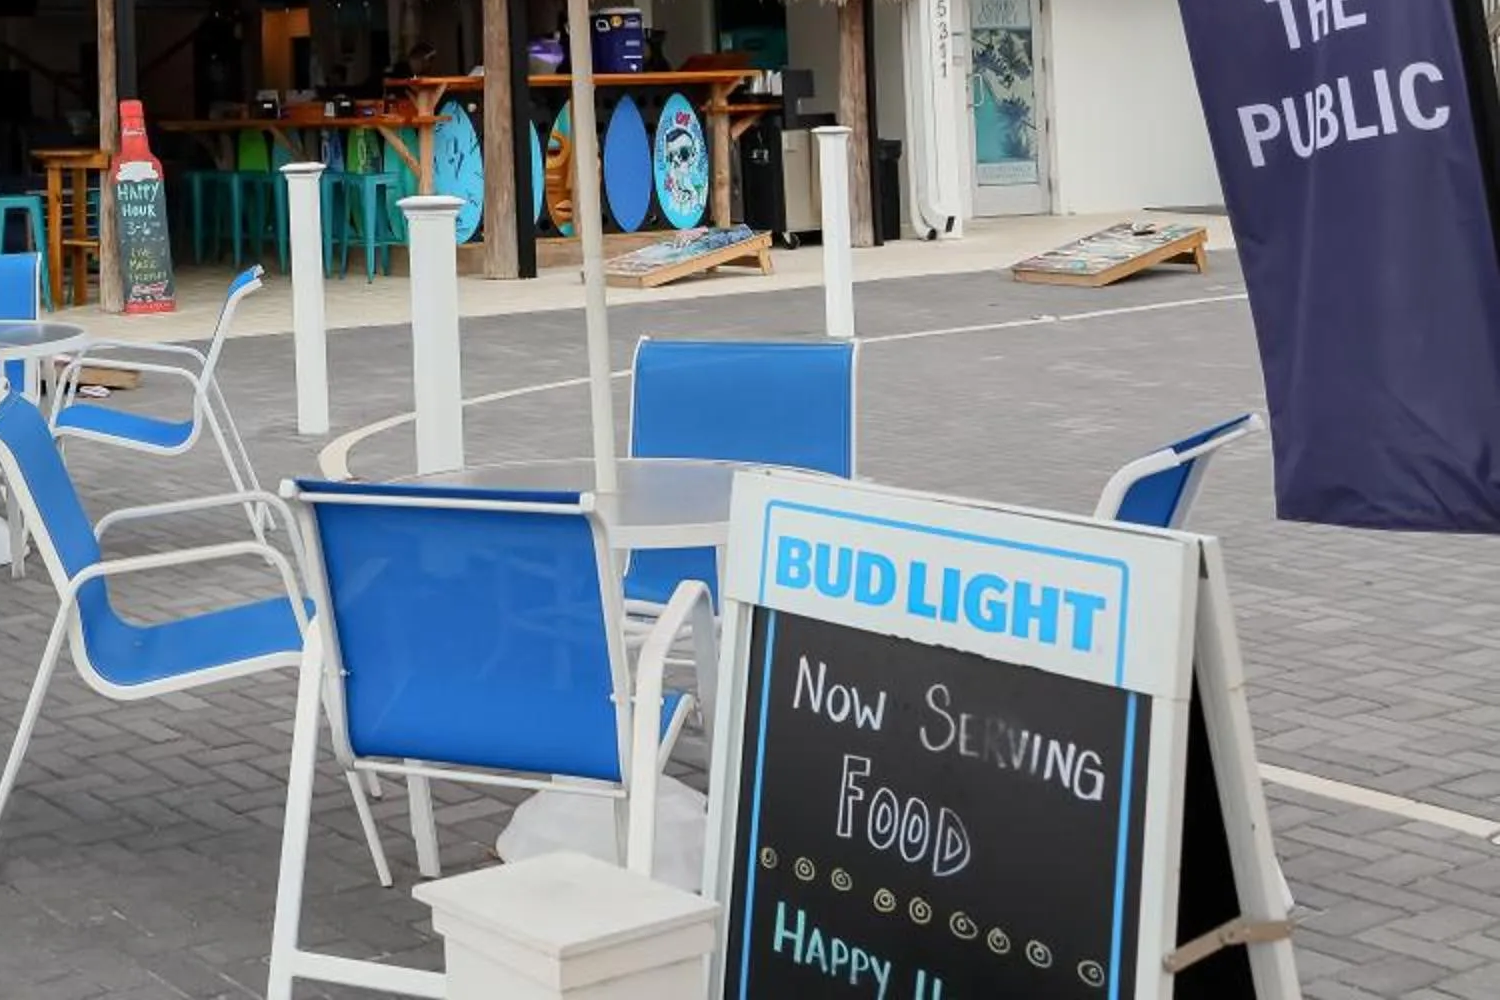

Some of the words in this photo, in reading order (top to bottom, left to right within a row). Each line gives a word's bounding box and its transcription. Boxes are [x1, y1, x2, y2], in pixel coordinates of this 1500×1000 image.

[1237, 61, 1451, 168] PUBLIC
[117, 182, 160, 202] HAPPY
[122, 204, 157, 217] HOUR
[775, 535, 897, 607] BUD
[906, 560, 1107, 653] LIGHT
[792, 655, 887, 731] NOW
[919, 683, 1107, 802] SERVING
[836, 754, 972, 878] FOOD
[773, 901, 892, 1000] HAPPY
